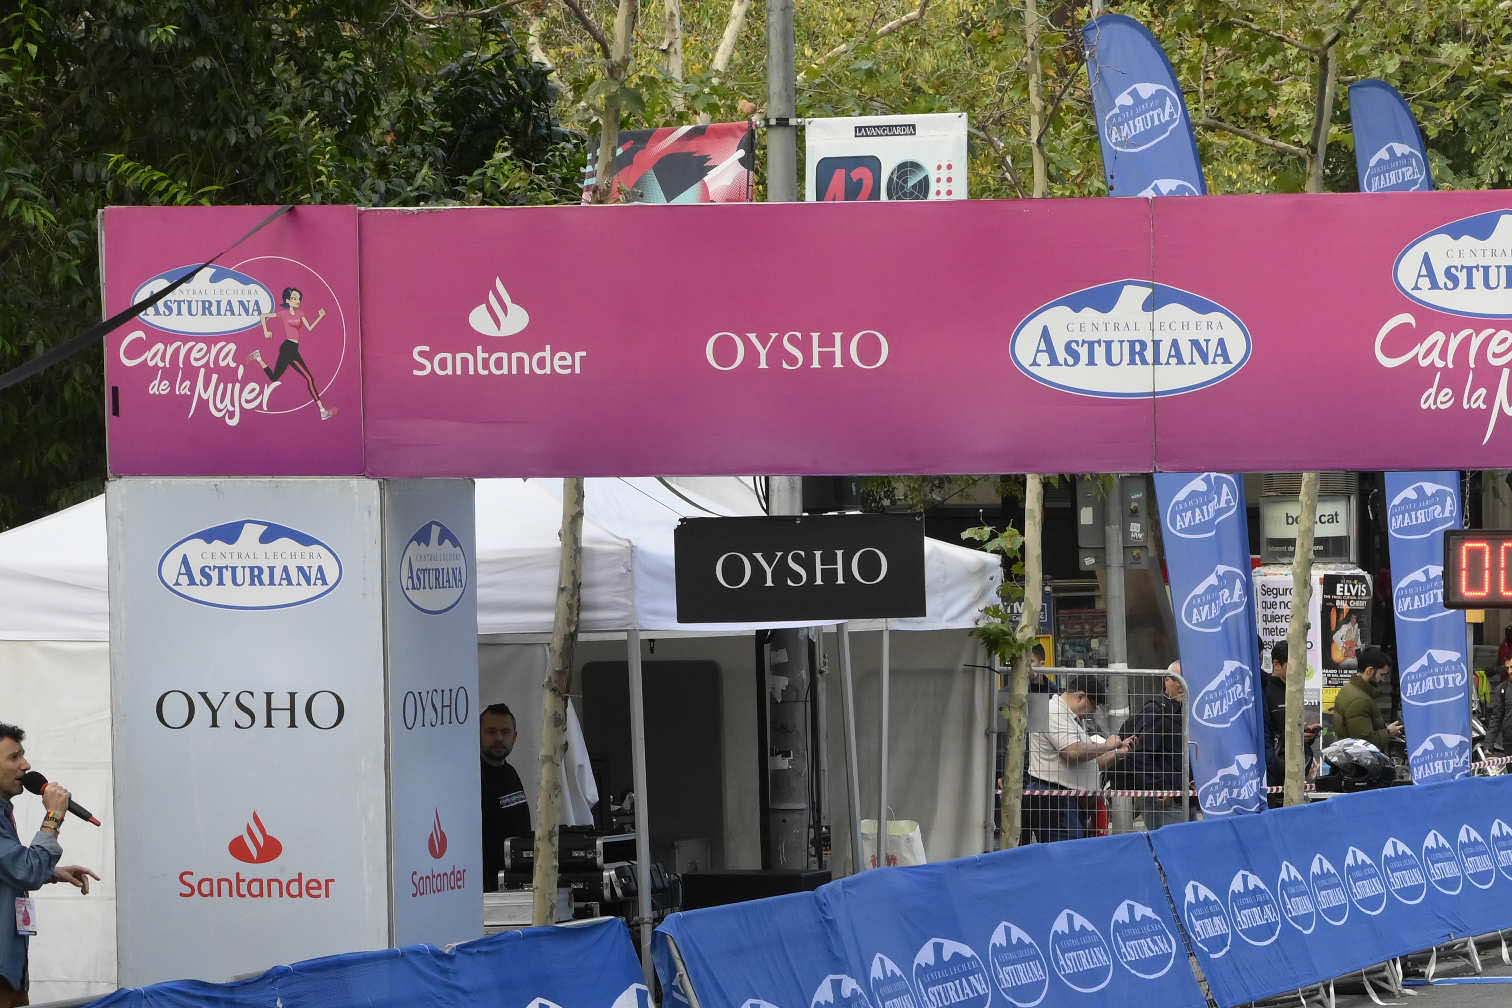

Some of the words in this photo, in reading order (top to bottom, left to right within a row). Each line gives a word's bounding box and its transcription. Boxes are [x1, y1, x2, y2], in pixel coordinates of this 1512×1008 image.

[142, 290, 262, 317] ASTURIANA
[1066, 321, 1141, 333] CENTRAL
[1148, 320, 1225, 332] LECHERA
[119, 330, 237, 368] Carrera
[412, 345, 587, 376] Santander
[705, 331, 889, 371] OYSHO
[1029, 324, 1233, 368] ASTURIANA
[149, 369, 171, 395] de
[175, 369, 191, 395] la
[188, 364, 282, 426] Mujer
[1420, 371, 1454, 411] de
[1462, 370, 1487, 410] la
[173, 552, 329, 588] ASTURIANA
[200, 551, 259, 561] CENTRAL
[264, 550, 323, 560] LECHERA
[405, 553, 464, 593] ASTURIANA
[715, 547, 888, 589] OYSHO
[1261, 601, 1277, 610] que
[1336, 584, 1367, 595] ELVIS
[1262, 613, 1293, 624] quiere
[155, 689, 345, 730] OYSHO
[402, 686, 469, 731] OYSHO
[178, 870, 335, 900] Santander
[411, 864, 467, 899] Santander
[994, 956, 1046, 989] ASTURIANA
[1055, 943, 1110, 976] ASTURIANA
